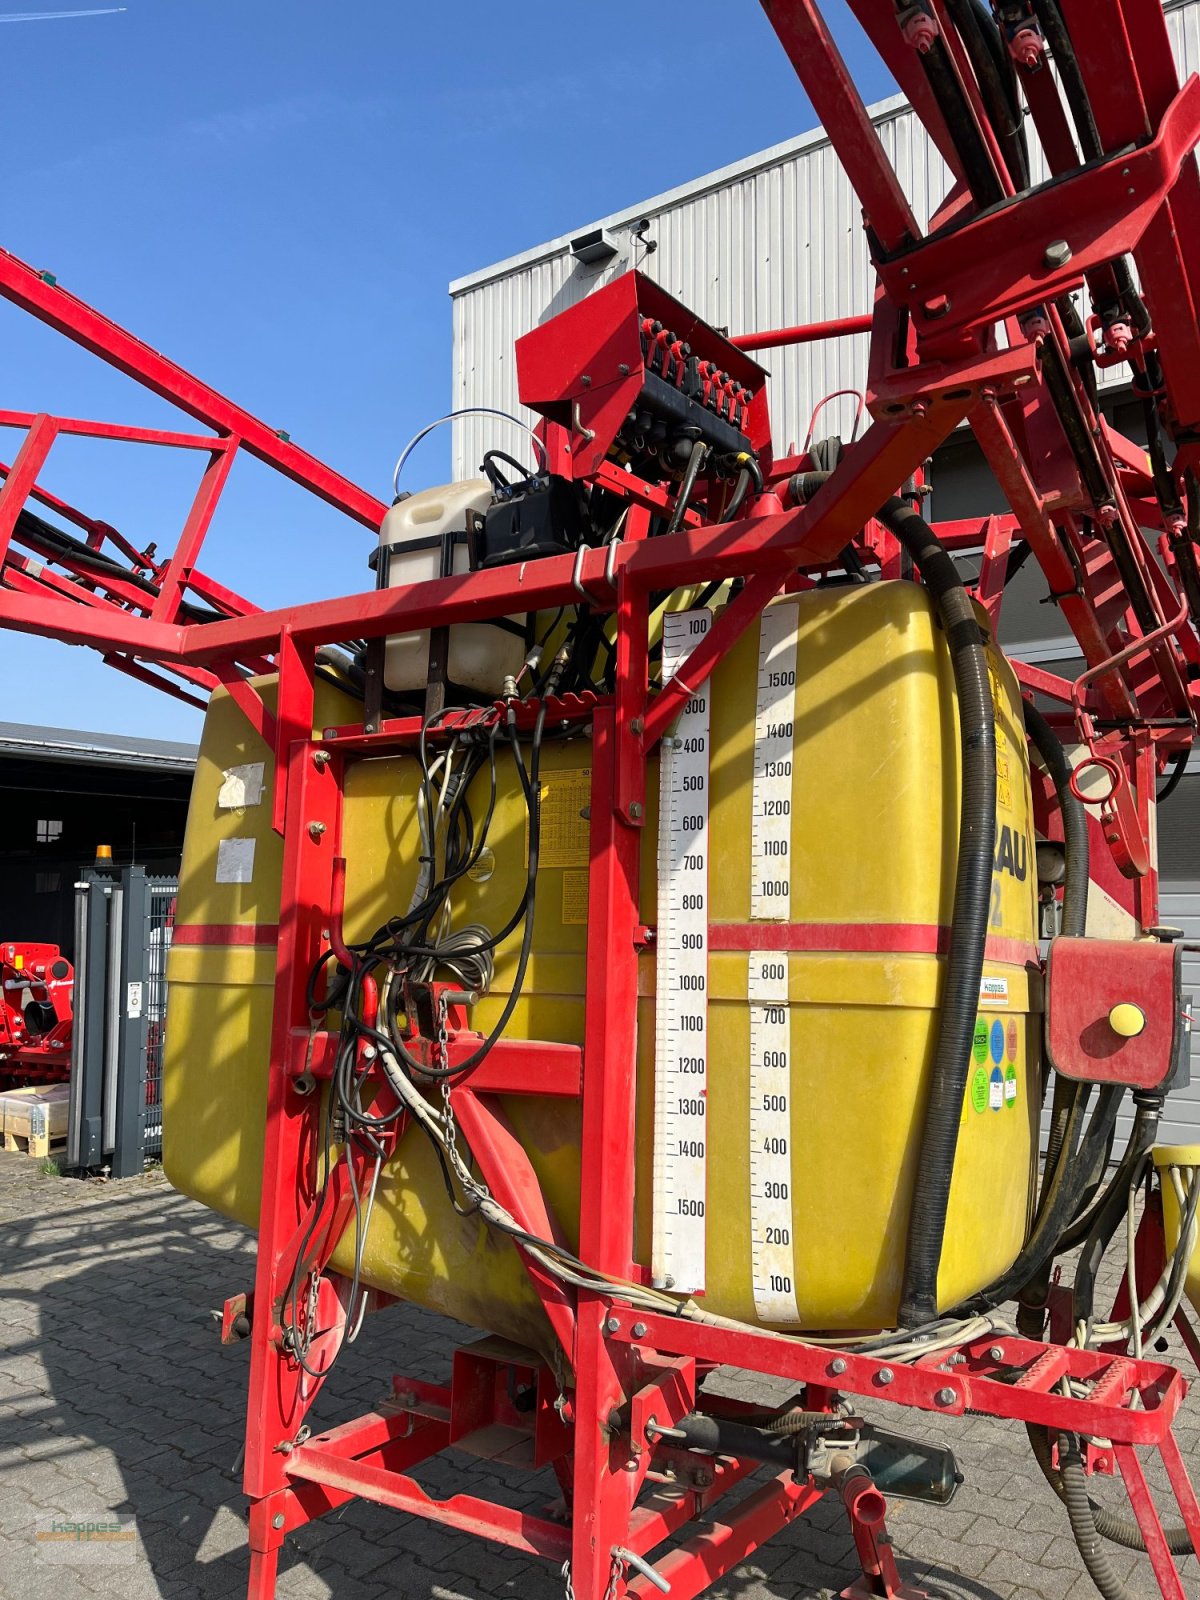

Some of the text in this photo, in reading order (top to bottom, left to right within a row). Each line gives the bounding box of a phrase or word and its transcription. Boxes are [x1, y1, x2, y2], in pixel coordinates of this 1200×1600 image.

[689, 619, 707, 634] 100
[768, 671, 795, 687] 1500
[766, 722, 793, 739] 1400
[683, 738, 704, 753] 400
[764, 761, 791, 777] 1300
[683, 776, 704, 791] 500
[763, 800, 790, 816] 1200
[682, 815, 703, 831] 600
[763, 840, 788, 856] 1100
[993, 820, 1027, 882] AU
[683, 855, 703, 870] 700
[761, 881, 788, 896] 1000
[682, 894, 703, 910] 800
[682, 934, 703, 949] 900
[761, 964, 785, 980] 800
[679, 975, 705, 991] 1000
[680, 1015, 703, 1031] 1100
[763, 1008, 785, 1025] 700
[678, 1057, 705, 1074] 1200
[763, 1051, 787, 1068] 600
[678, 1099, 705, 1116] 1300
[763, 1095, 787, 1112] 500
[678, 1140, 704, 1158] 1400
[763, 1137, 787, 1155] 400
[764, 1181, 788, 1200] 300
[678, 1199, 704, 1218] 1500
[766, 1227, 789, 1246] 200
[770, 1275, 791, 1293] 100
